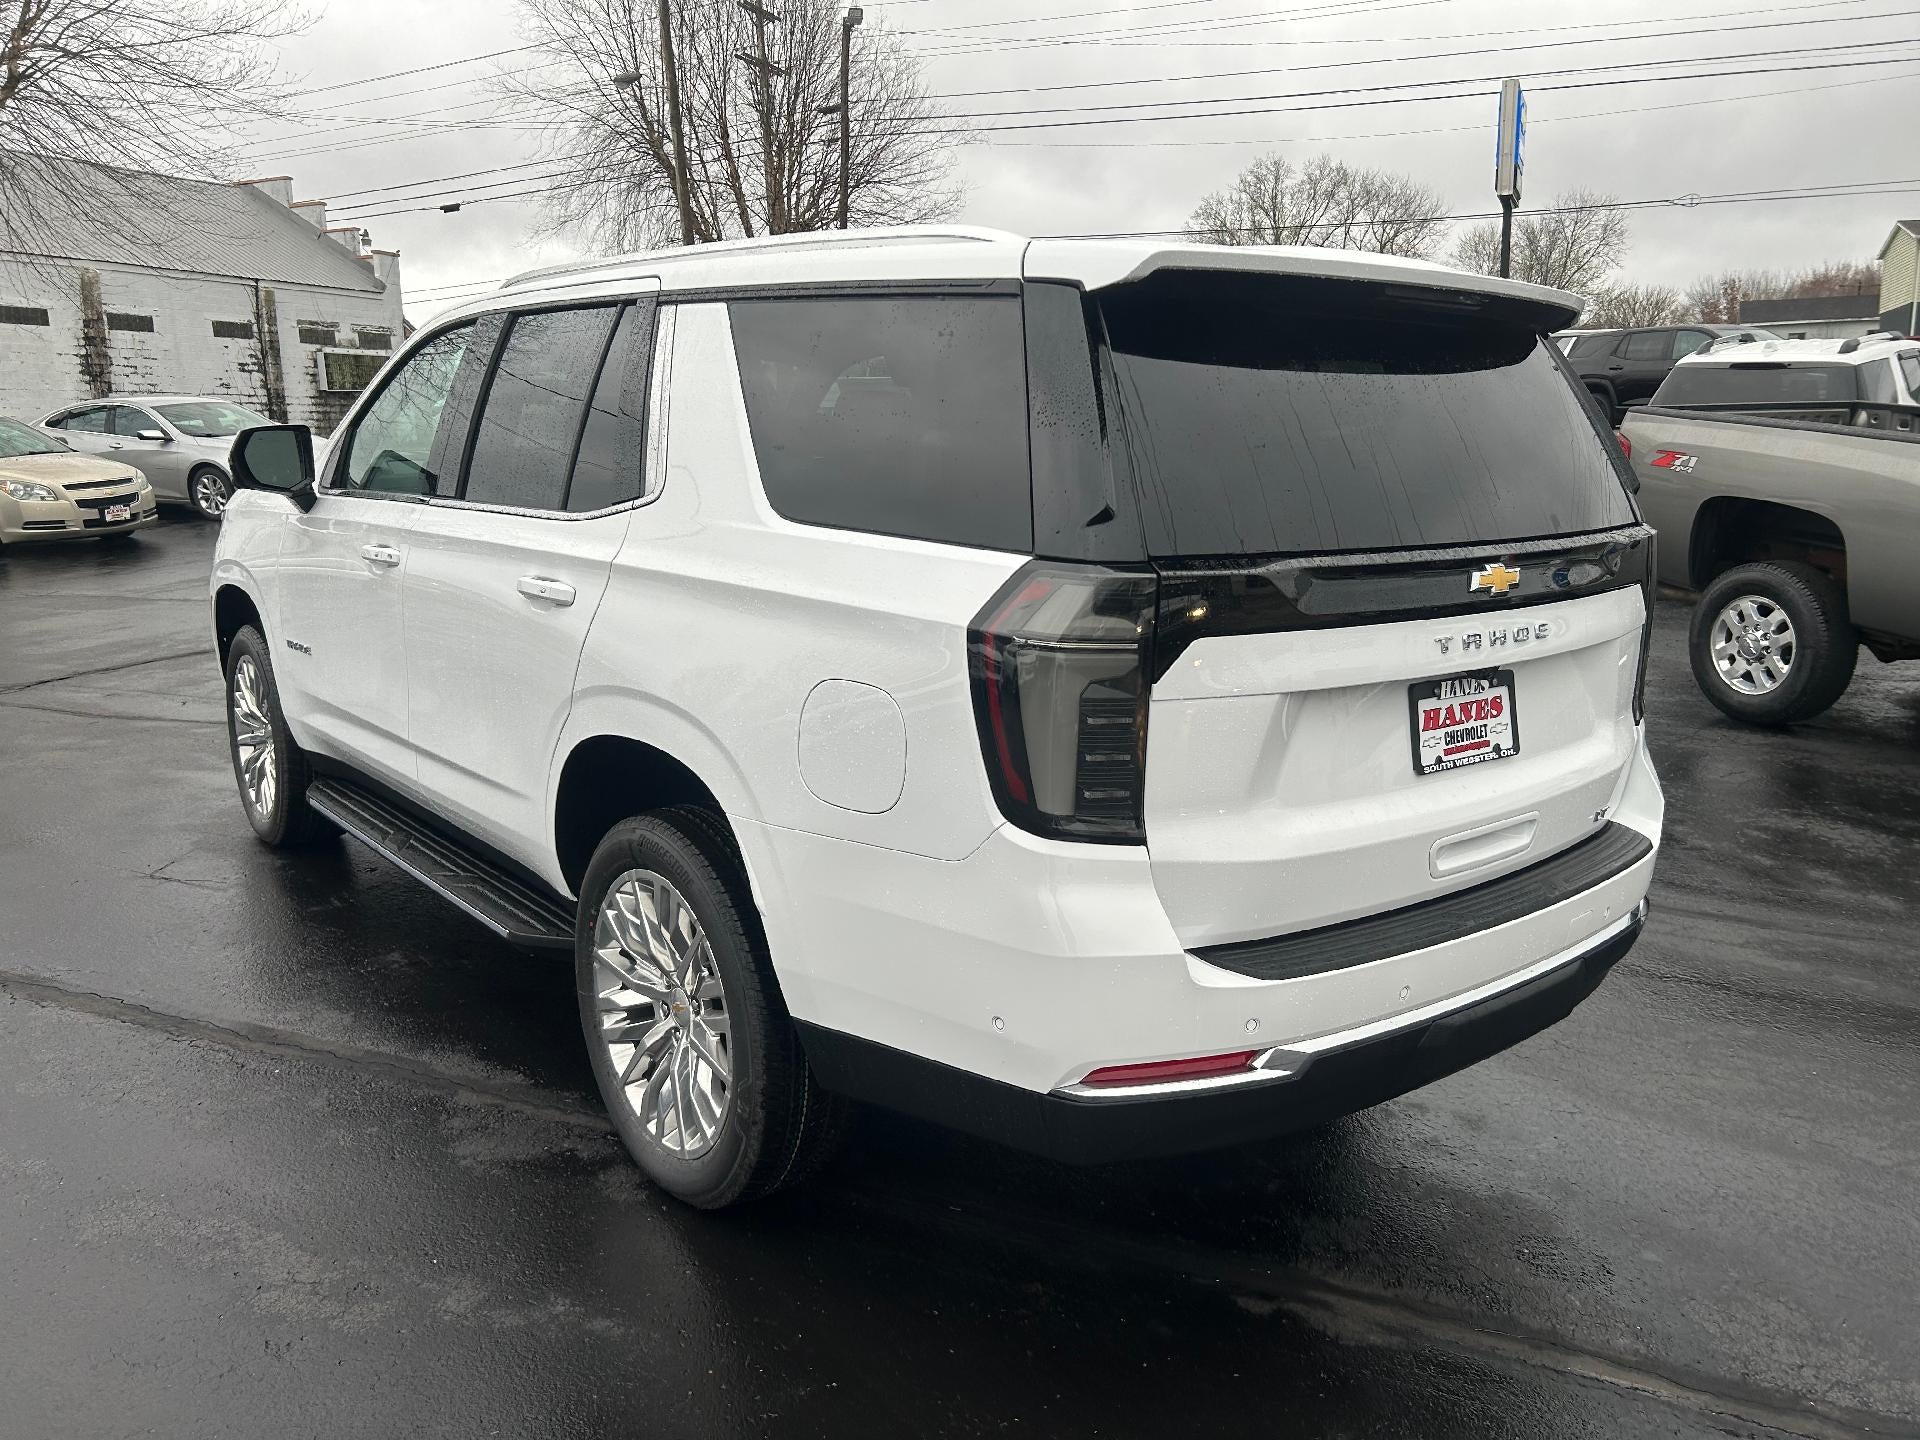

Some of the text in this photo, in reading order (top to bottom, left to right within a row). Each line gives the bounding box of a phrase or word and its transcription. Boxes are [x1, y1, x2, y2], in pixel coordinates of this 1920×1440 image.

[1434, 623, 1550, 654] TAHOE
[1440, 678, 1490, 700] HANES
[1422, 694, 1504, 732] HANES
[1444, 723, 1488, 746] CHEVROLET
[1423, 761, 1454, 774] SOUTH
